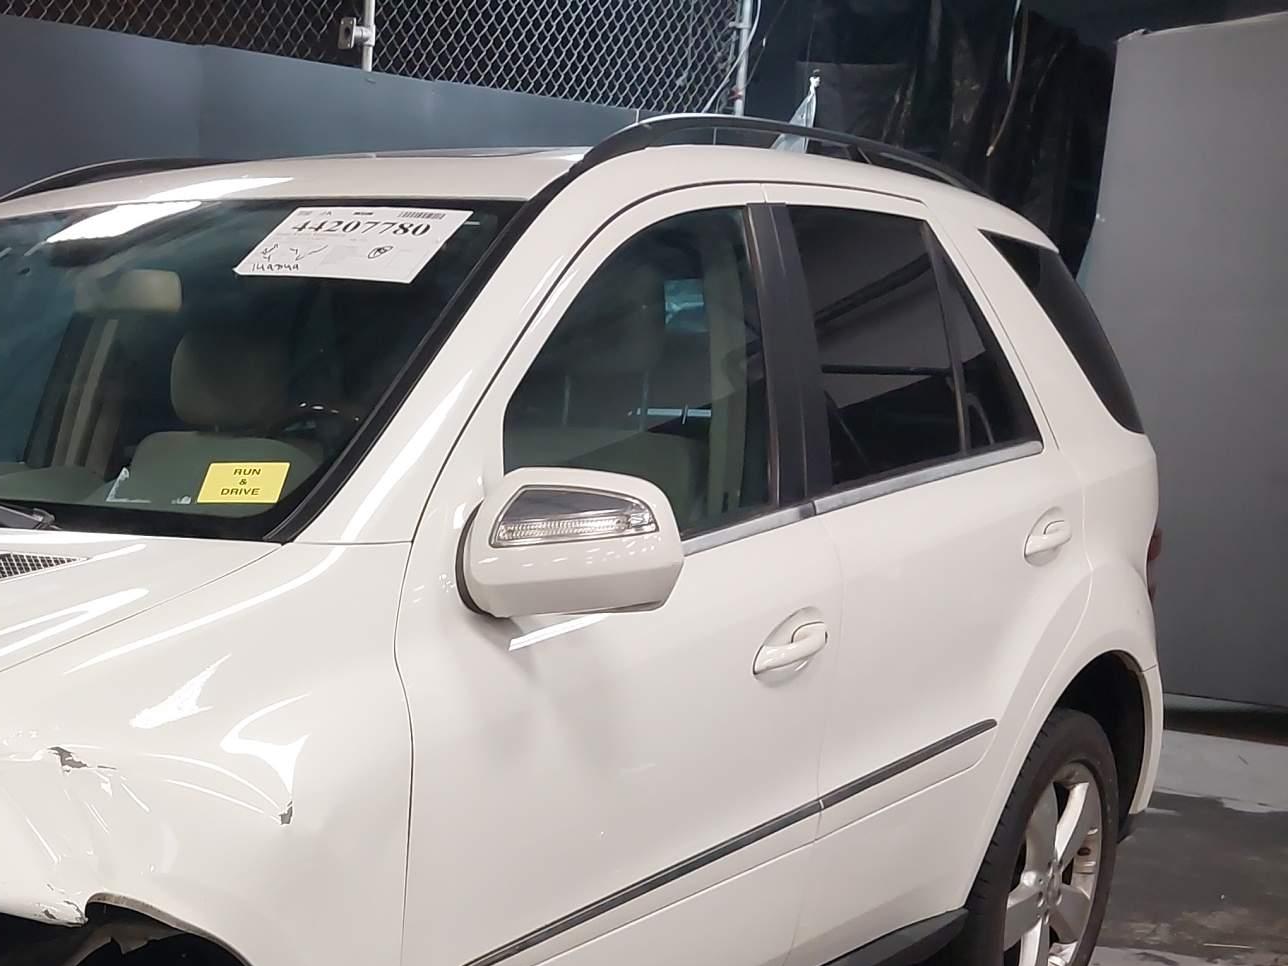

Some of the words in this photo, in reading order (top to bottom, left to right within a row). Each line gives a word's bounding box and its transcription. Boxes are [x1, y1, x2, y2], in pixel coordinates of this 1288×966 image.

[291, 219, 432, 237] 44207780
[233, 468, 262, 476] RUN
[239, 478, 248, 486] &
[220, 487, 261, 496] DRIVE
